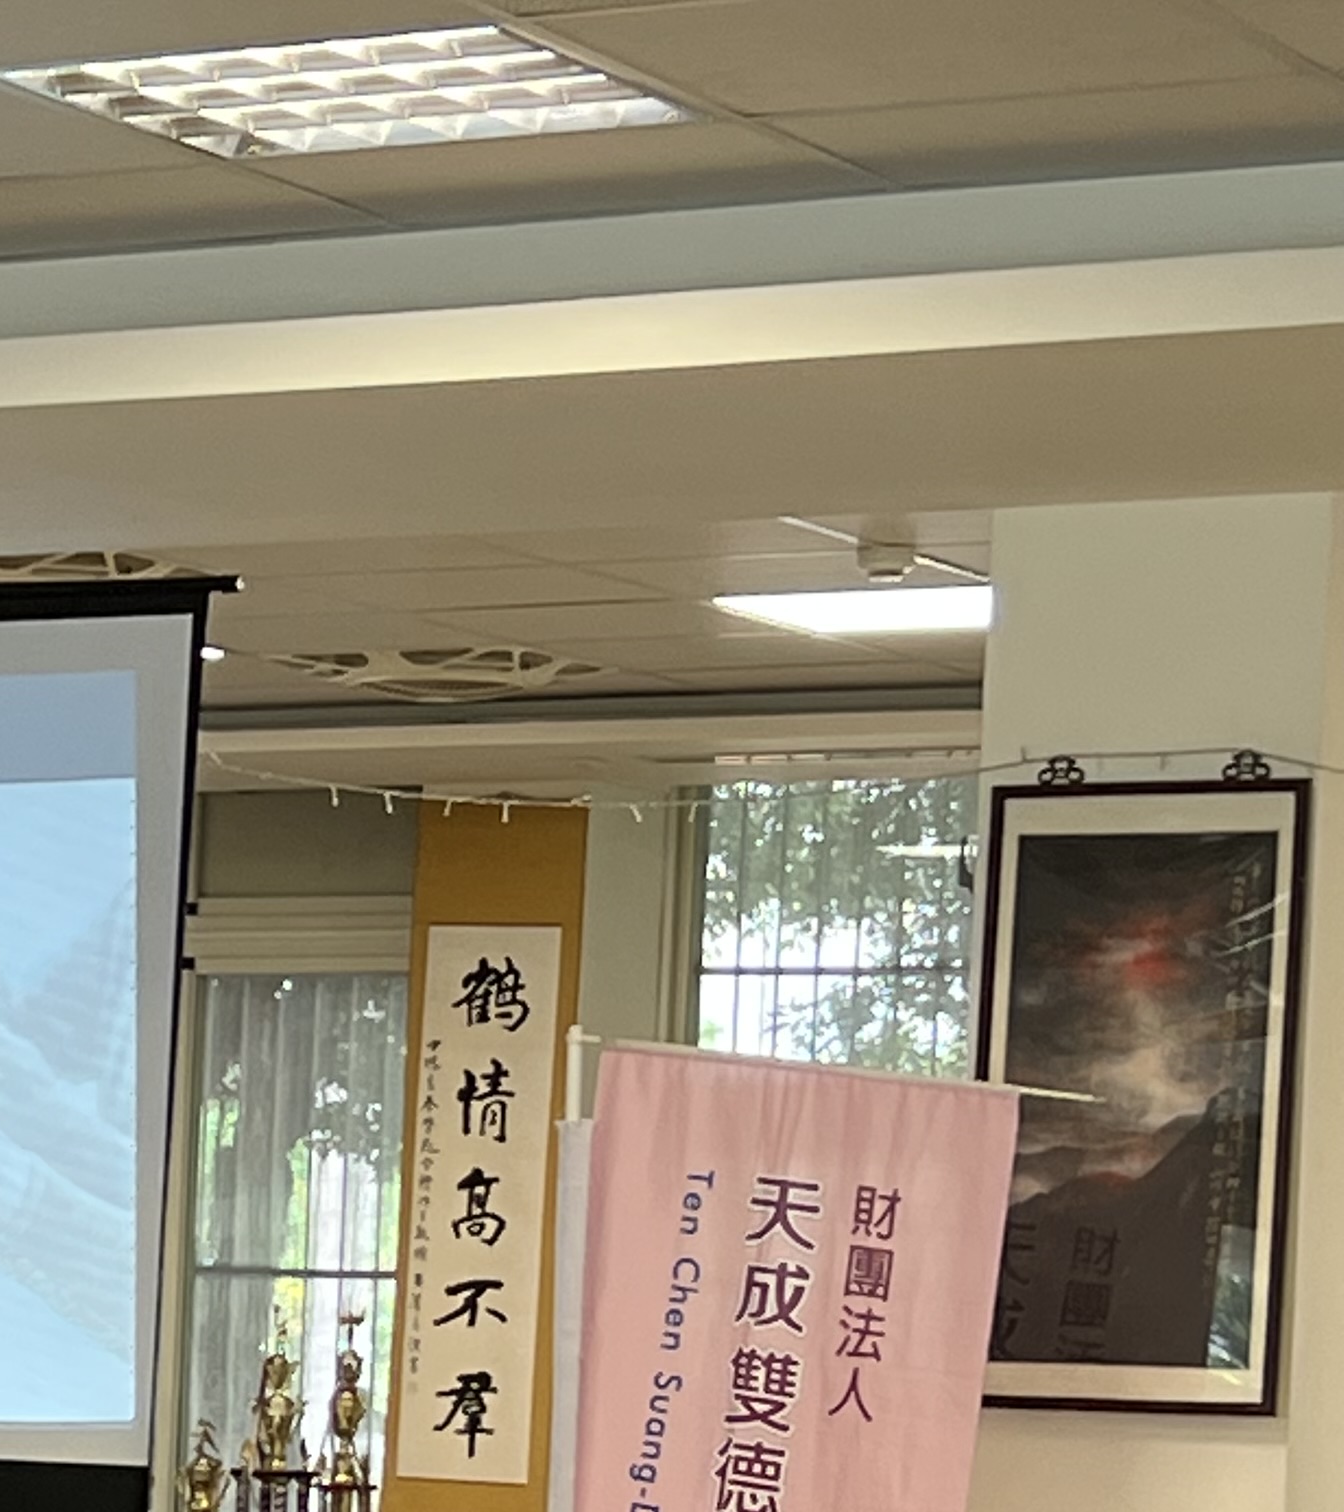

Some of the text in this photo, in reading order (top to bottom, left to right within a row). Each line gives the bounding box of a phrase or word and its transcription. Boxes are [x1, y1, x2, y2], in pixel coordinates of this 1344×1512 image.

[678, 1171, 715, 1236] Ten
[658, 1257, 700, 1351] Chen
[828, 1184, 902, 1424] 財團法人
